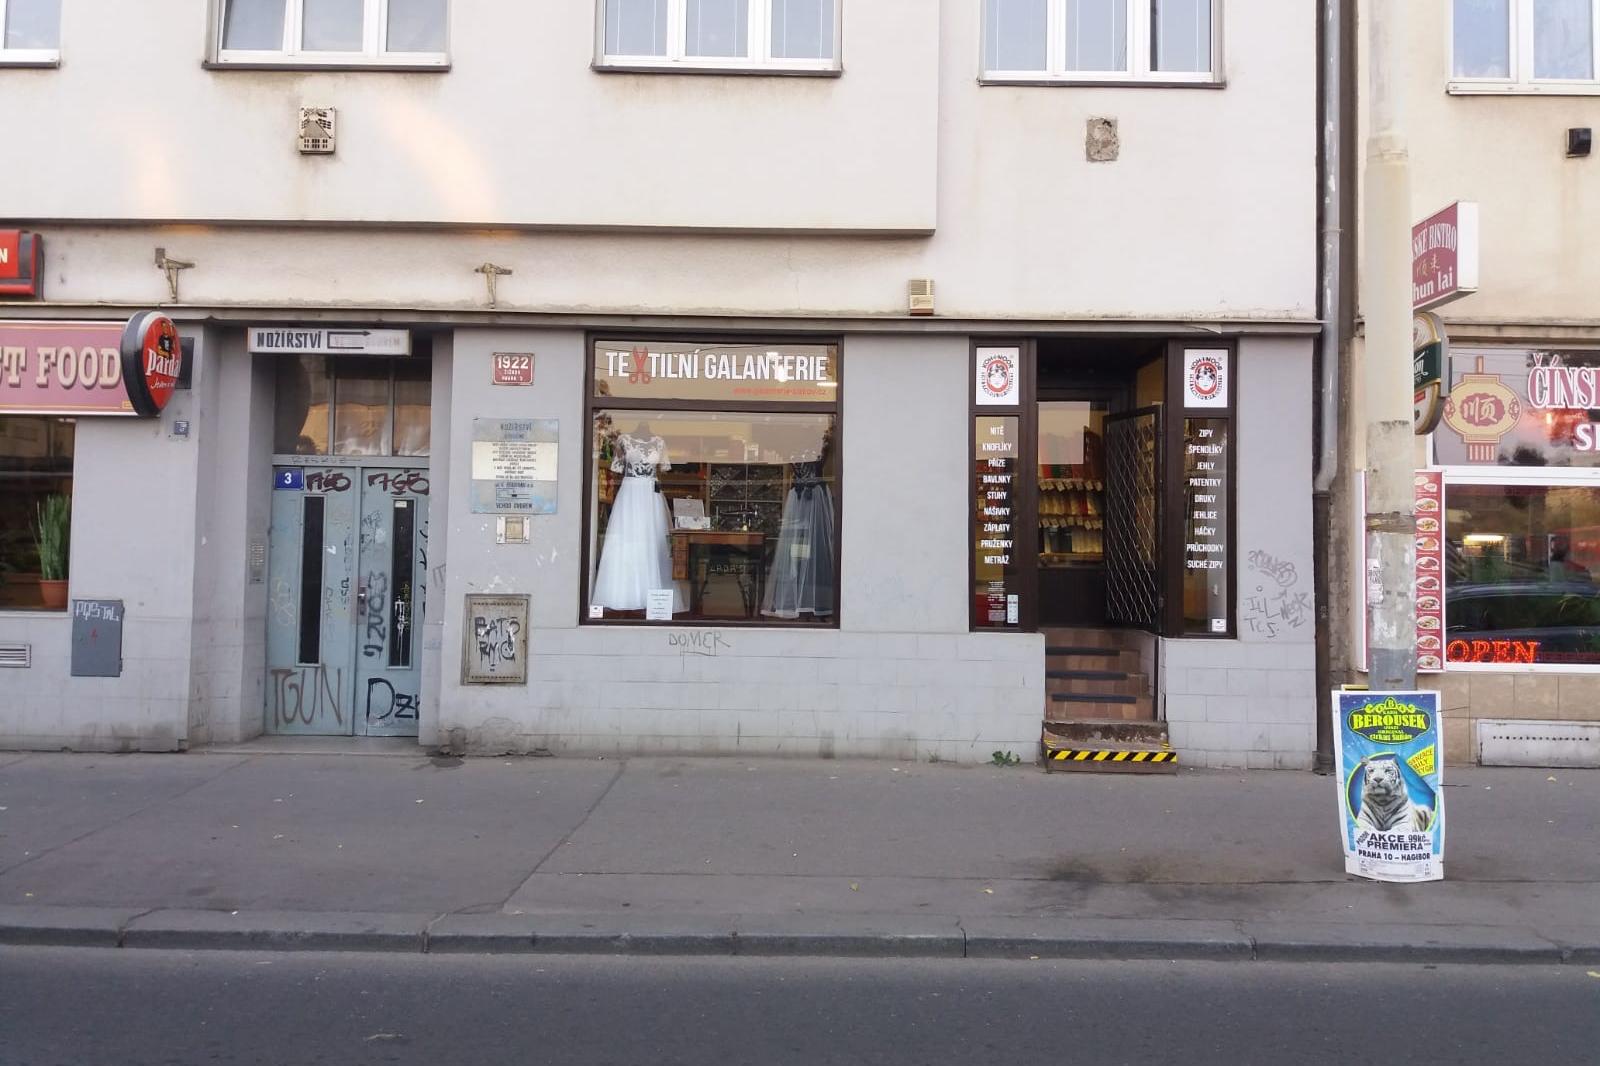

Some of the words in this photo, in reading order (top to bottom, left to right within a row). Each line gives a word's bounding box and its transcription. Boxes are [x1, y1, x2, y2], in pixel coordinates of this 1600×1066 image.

[1429, 223, 1456, 252] BISTRO
[1438, 266, 1453, 292] lai
[0, 346, 27, 387] T
[36, 346, 121, 387] FOOD
[498, 356, 529, 369] 1922
[705, 352, 828, 381] GALANTERIE
[1198, 429, 1214, 438] ZIPY
[982, 442, 1012, 451] KNOFLÍKY
[1188, 444, 1223, 454] ŠPENDLÍKY
[1196, 461, 1215, 470] JEHLY
[284, 473, 292, 484] 3
[1189, 478, 1222, 487] PATENTKY
[987, 491, 1007, 500] STUHY
[1194, 494, 1216, 503] DRUKY
[1193, 511, 1218, 520] JEHLICE
[983, 523, 1011, 532] ZÁPLATY
[1194, 526, 1216, 536] HÁČKY
[1186, 559, 1208, 569] SUCHÉ
[1208, 560, 1223, 569] ZIPY
[1447, 639, 1540, 663] OPEN
[1353, 714, 1427, 729] BEROUSEK
[1370, 833, 1405, 843] AKCE
[1358, 849, 1382, 859] PRAHA
[1401, 853, 1431, 861] HAGIBOR
